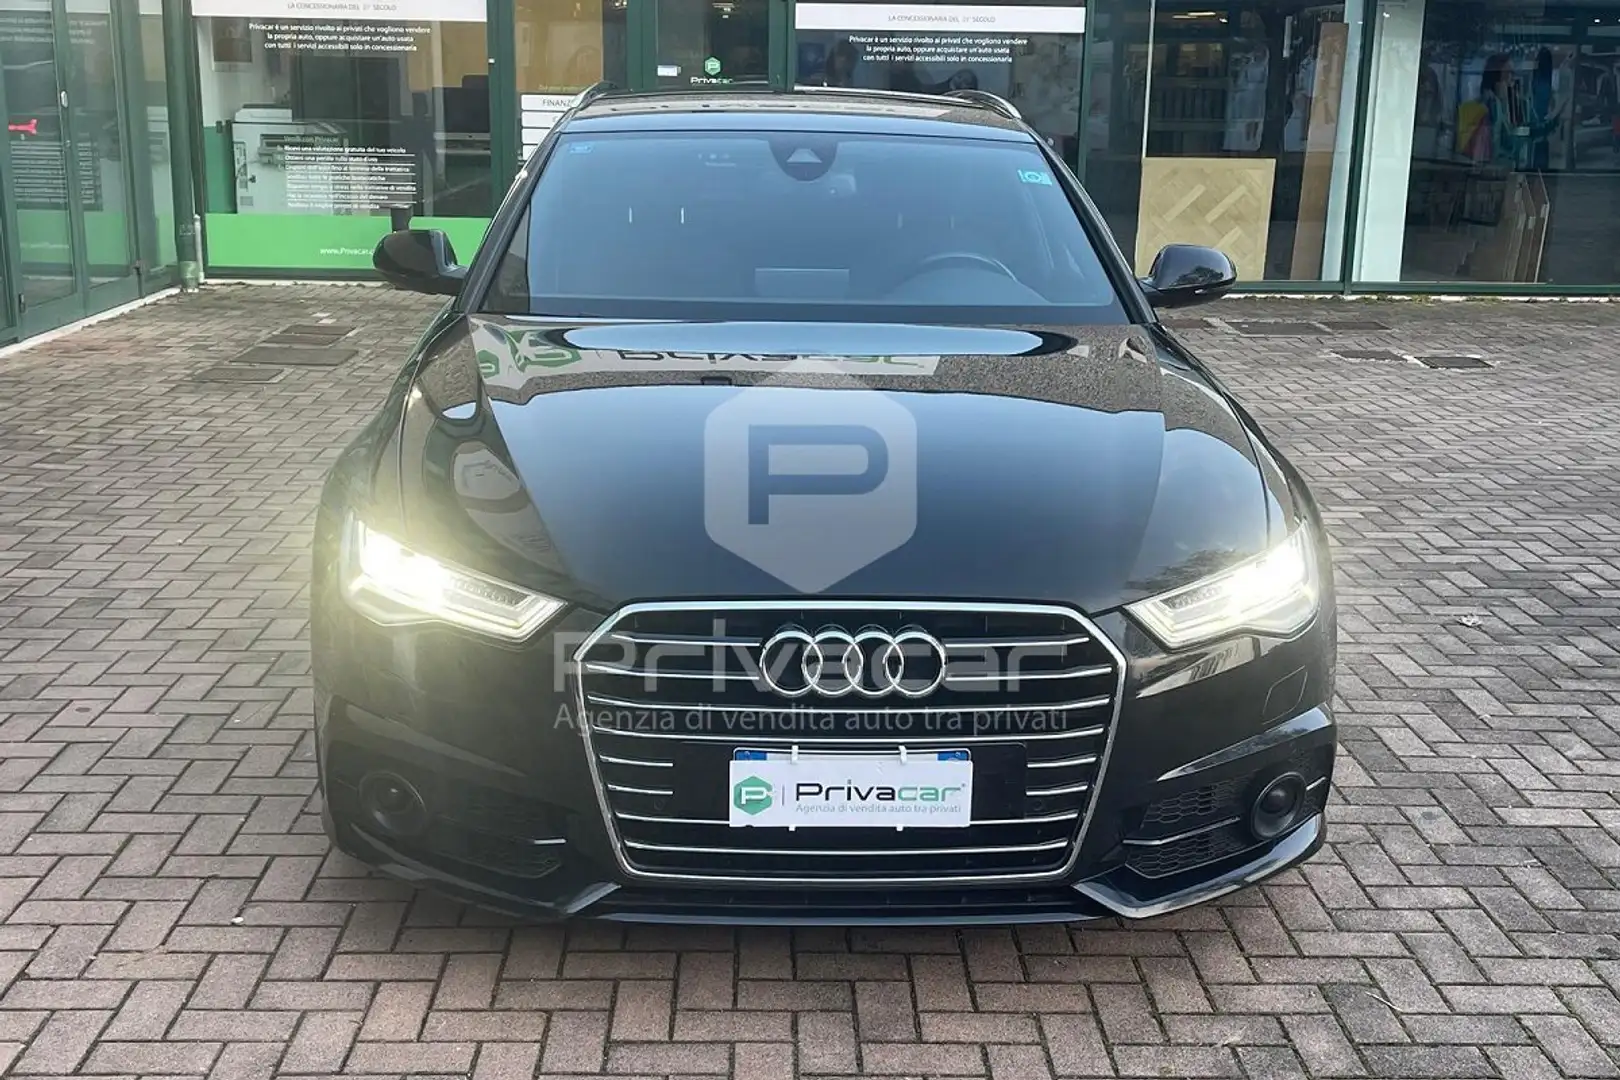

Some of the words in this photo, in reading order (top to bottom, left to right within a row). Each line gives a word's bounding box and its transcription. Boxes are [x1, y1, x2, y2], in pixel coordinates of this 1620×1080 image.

[690, 76, 734, 84] Privacar
[796, 803, 835, 814] Agenzia
[838, 803, 847, 812] di
[850, 803, 887, 812] vendita
[888, 804, 912, 812] auto
[914, 804, 926, 812] tra
[929, 803, 961, 814] privati
